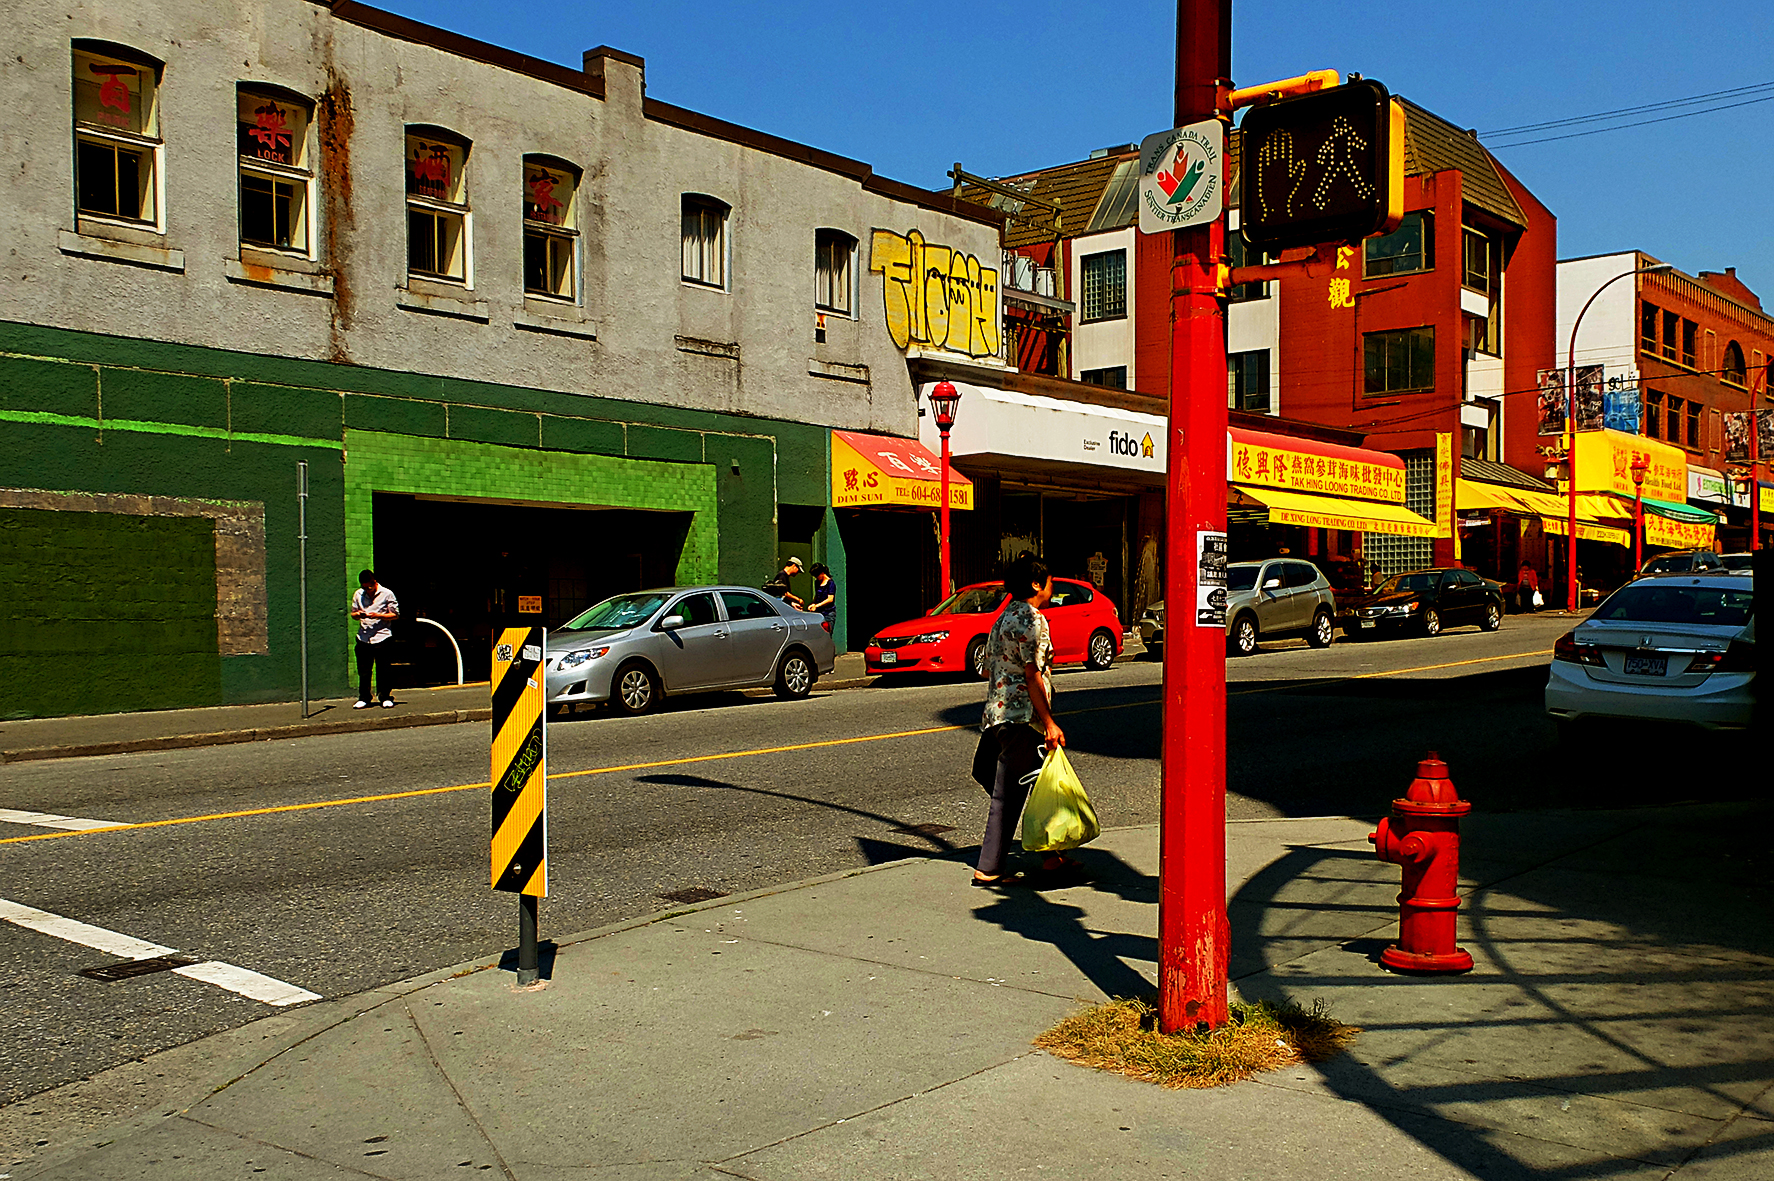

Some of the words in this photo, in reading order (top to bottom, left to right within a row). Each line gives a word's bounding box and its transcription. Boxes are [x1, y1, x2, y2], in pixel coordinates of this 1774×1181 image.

[257, 148, 286, 163] LOCK
[1145, 143, 1164, 176] TRANS
[1166, 130, 1198, 146] CANADA
[1200, 135, 1218, 165] TRAIL
[1144, 189, 1166, 223] SENTIER
[1166, 174, 1218, 224] TRANSCANADIEN
[1108, 430, 1139, 457] fido
[837, 494, 858, 504] DIM
[861, 493, 884, 503] SUM
[895, 486, 910, 498] TEL:
[1291, 476, 1305, 488] TAK
[1306, 478, 1323, 491] HING
[1324, 480, 1349, 494] LOONG
[1350, 484, 1378, 498] TRADING
[1379, 487, 1390, 499] CO.
[1390, 489, 1404, 501] LTD.
[1281, 511, 1290, 521] DE
[1290, 512, 1306, 524] XING
[1306, 514, 1322, 525] LONG
[1322, 516, 1347, 529] TRADING
